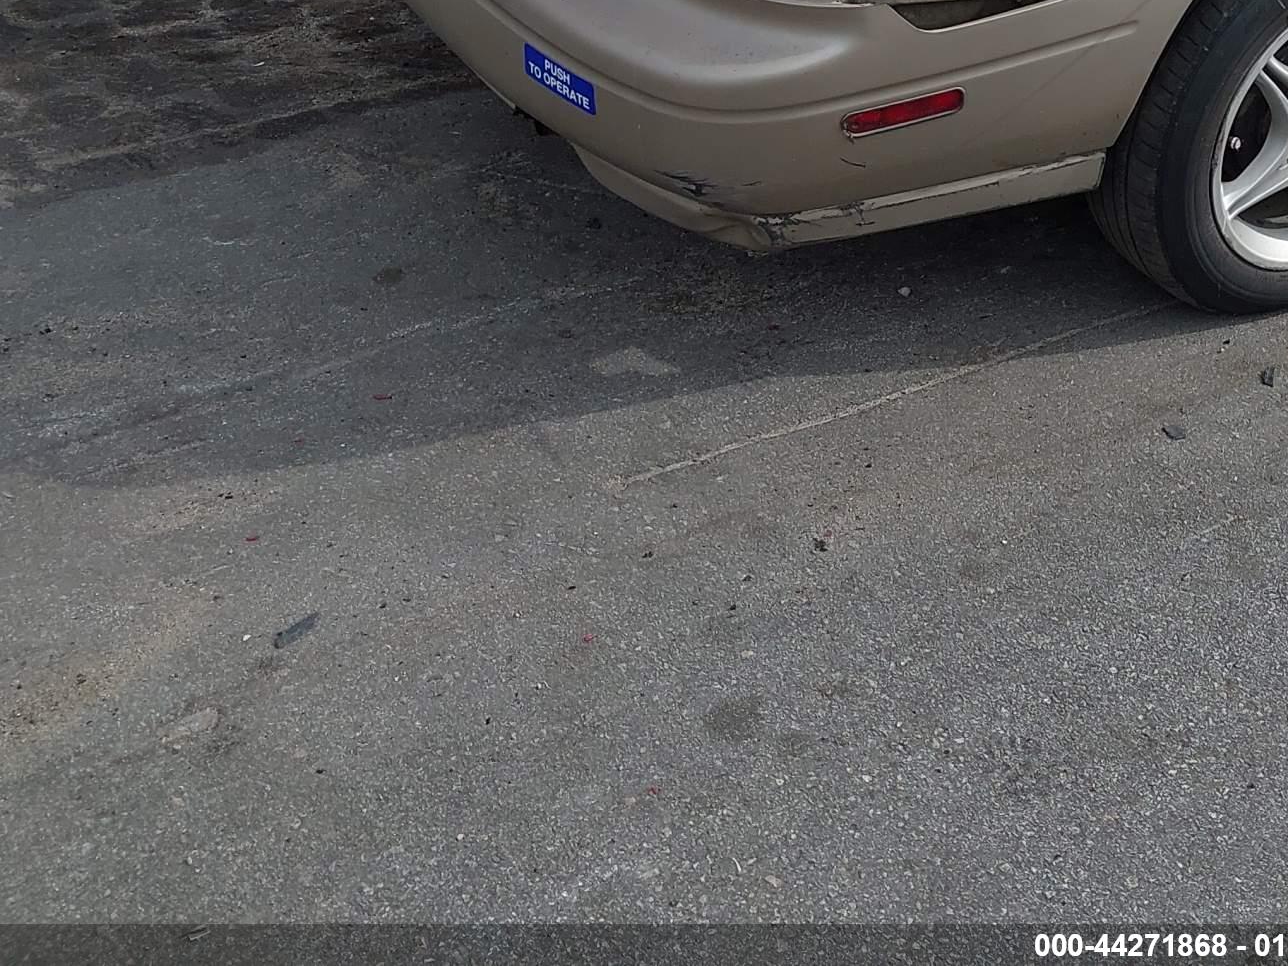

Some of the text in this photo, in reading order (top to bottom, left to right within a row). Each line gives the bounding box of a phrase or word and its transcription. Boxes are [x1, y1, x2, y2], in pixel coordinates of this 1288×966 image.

[528, 61, 590, 110] TO OPERATE
[544, 58, 570, 85] PUSH
